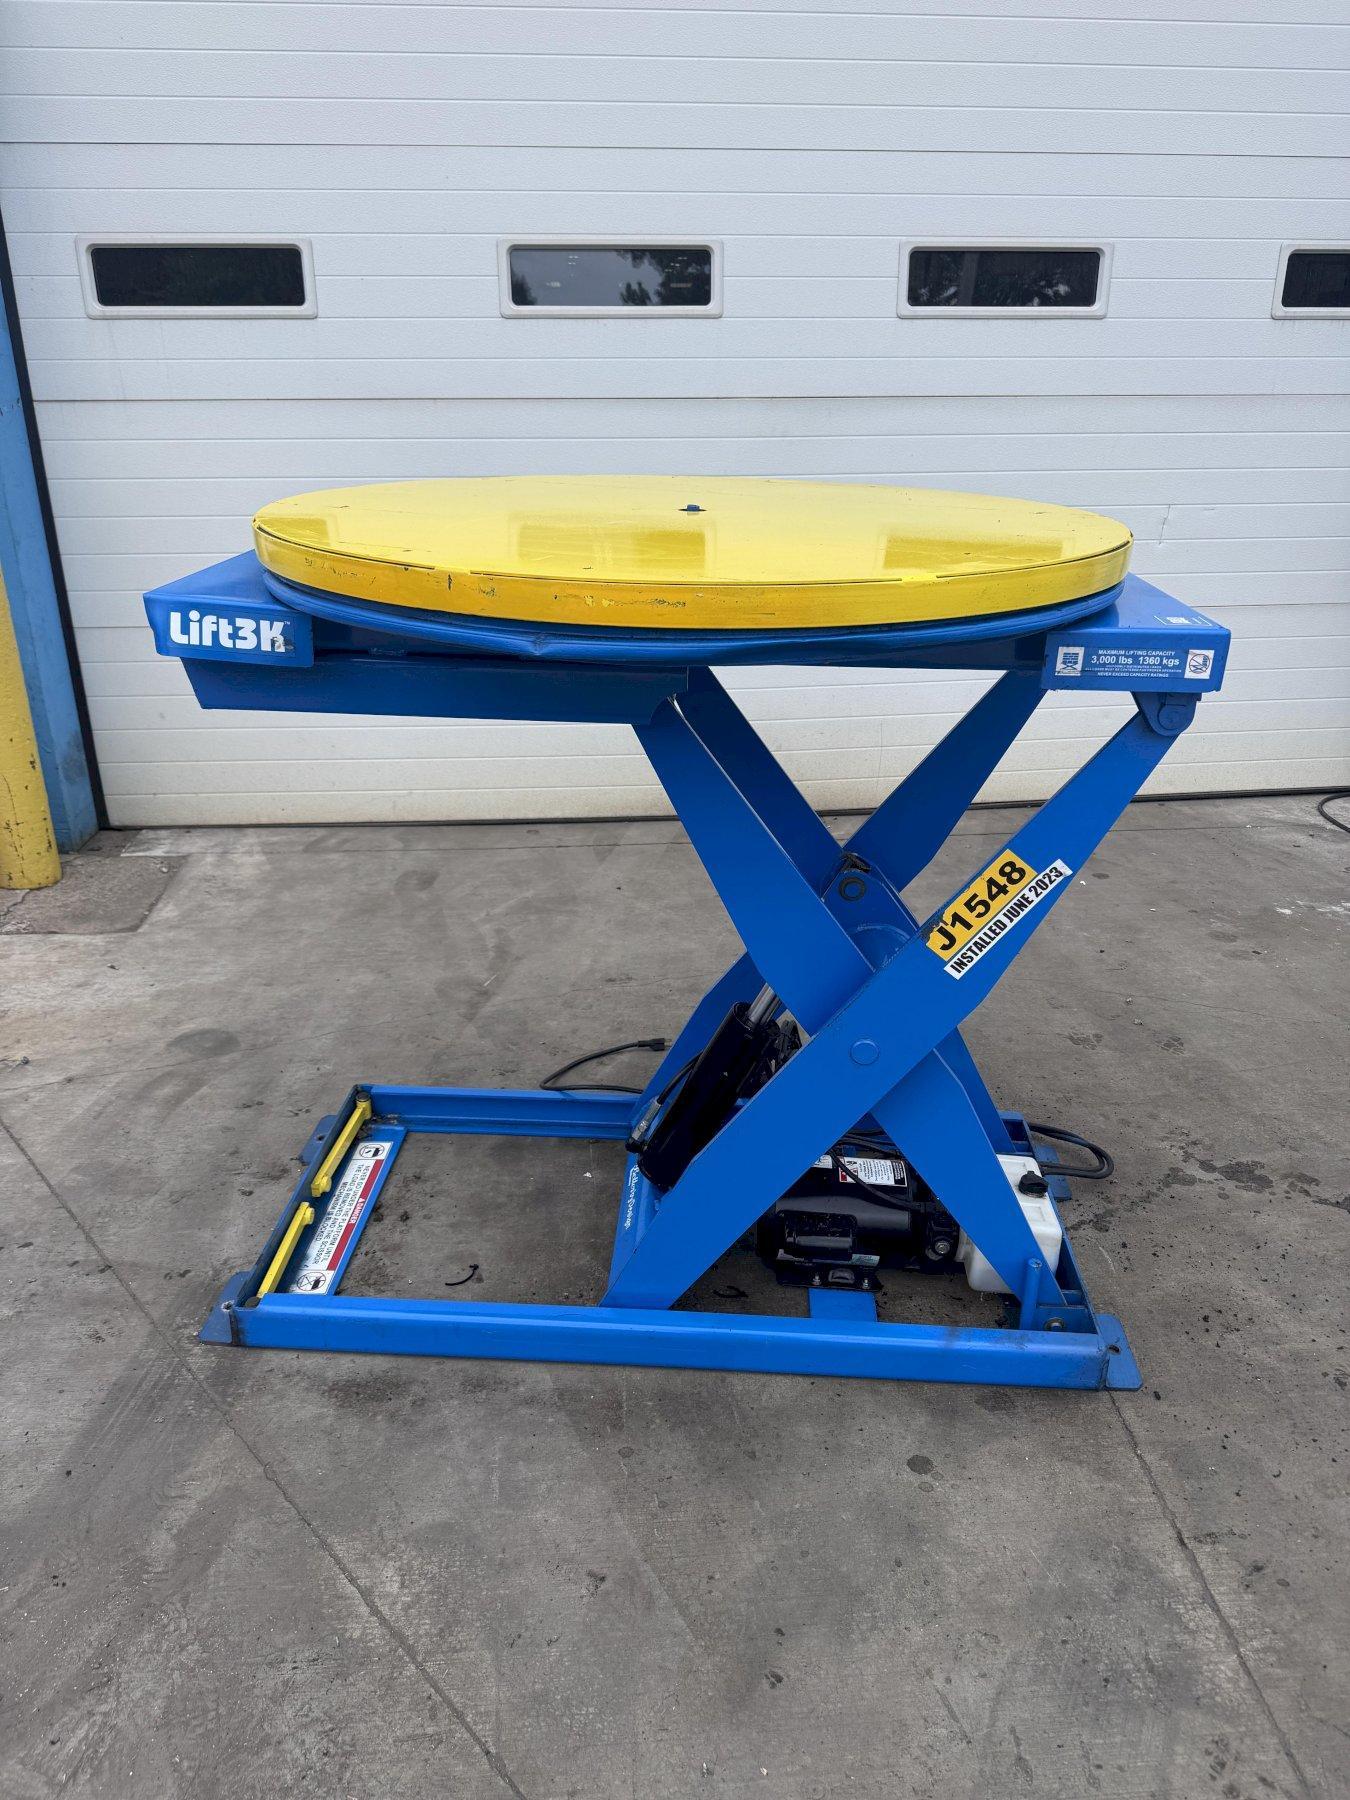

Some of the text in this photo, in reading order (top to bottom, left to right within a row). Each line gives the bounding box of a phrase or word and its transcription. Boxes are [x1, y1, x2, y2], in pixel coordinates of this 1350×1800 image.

[1091, 655, 1180, 667] 3,000 lbs 1360 kgs
[938, 860, 1027, 952] J1548
[949, 866, 1064, 974] INSTALLED JUNE 2023
[329, 1181, 348, 1210] MECHANISM
[334, 1192, 351, 1216] REMOVED
[328, 1218, 347, 1245] PLATFORM
